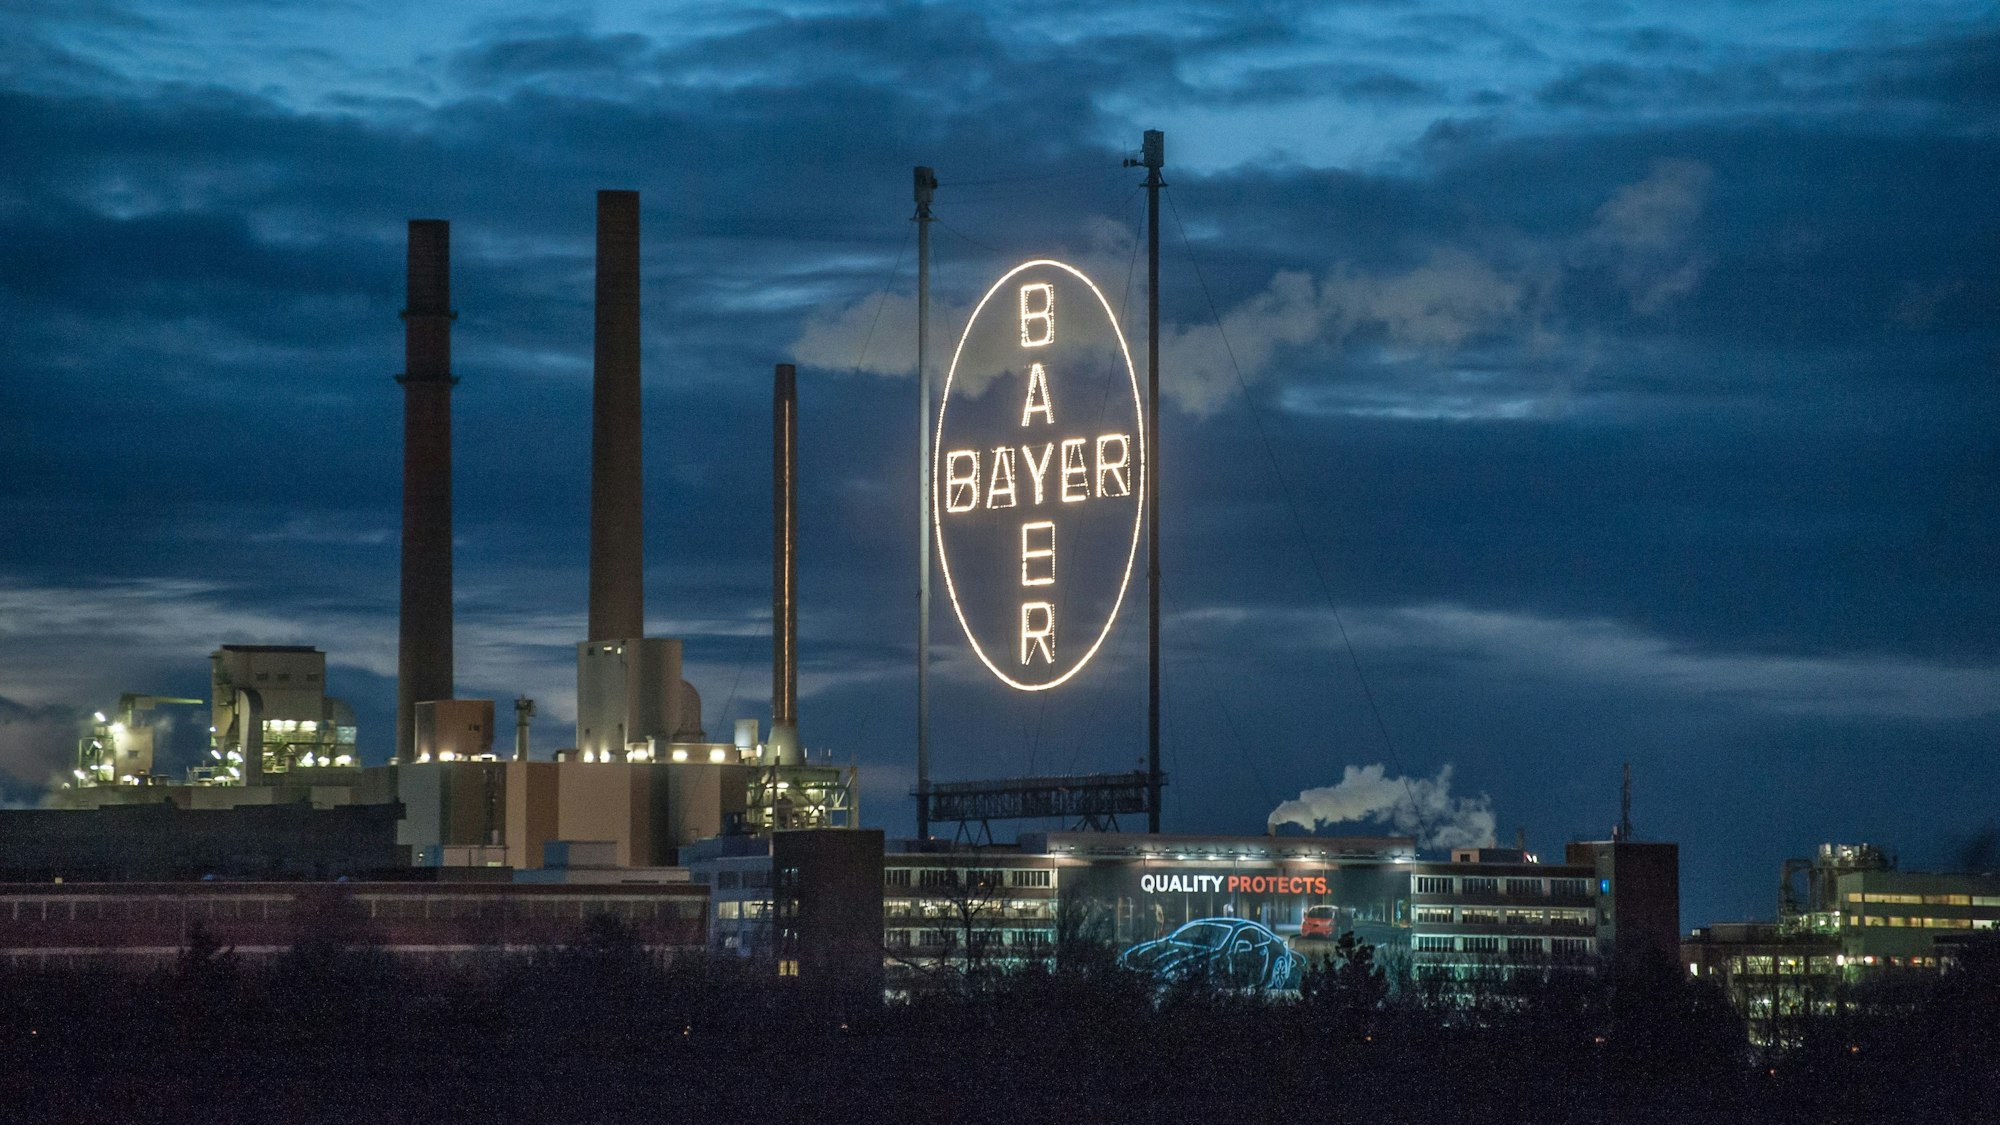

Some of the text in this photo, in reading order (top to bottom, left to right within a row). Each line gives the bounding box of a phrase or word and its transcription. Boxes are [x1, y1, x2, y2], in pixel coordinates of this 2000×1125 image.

[946, 433, 1131, 512] BAYER
[1020, 283, 1054, 666] BAYER
[1140, 874, 1332, 895] QUALITY PROTECTS.
